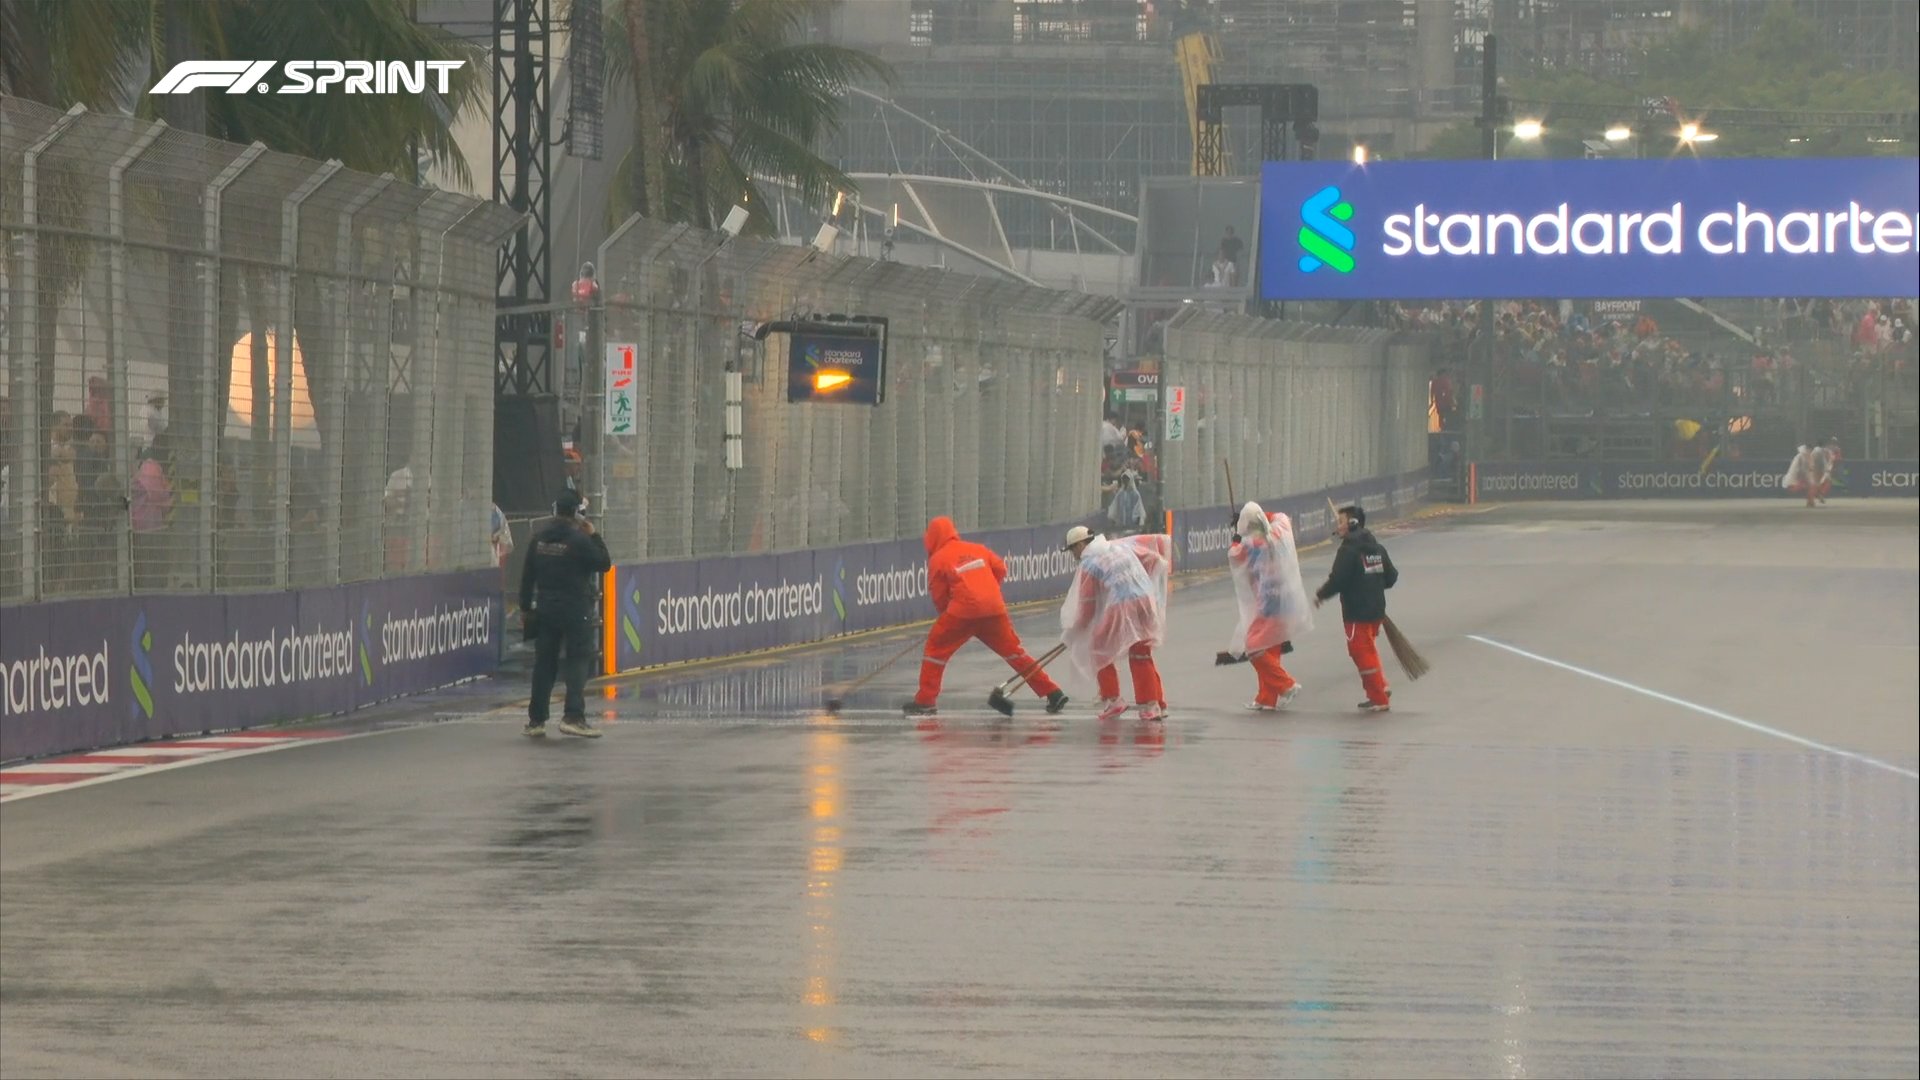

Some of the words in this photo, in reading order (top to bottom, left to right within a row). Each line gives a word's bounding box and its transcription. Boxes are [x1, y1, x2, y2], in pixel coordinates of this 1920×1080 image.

[1382, 201, 1682, 256] standard
[1698, 200, 1919, 256] charte
[824, 349, 861, 358] standard
[824, 355, 863, 365] chartered
[1519, 471, 1579, 490] chartered
[1618, 470, 1700, 489] standard
[856, 559, 915, 606] standard
[1003, 545, 1050, 583] standard
[657, 581, 742, 635] standard
[744, 572, 823, 625] chartered
[381, 603, 437, 666] standard
[437, 594, 491, 655] chartered
[174, 626, 276, 694] standard
[280, 618, 353, 684] chartered
